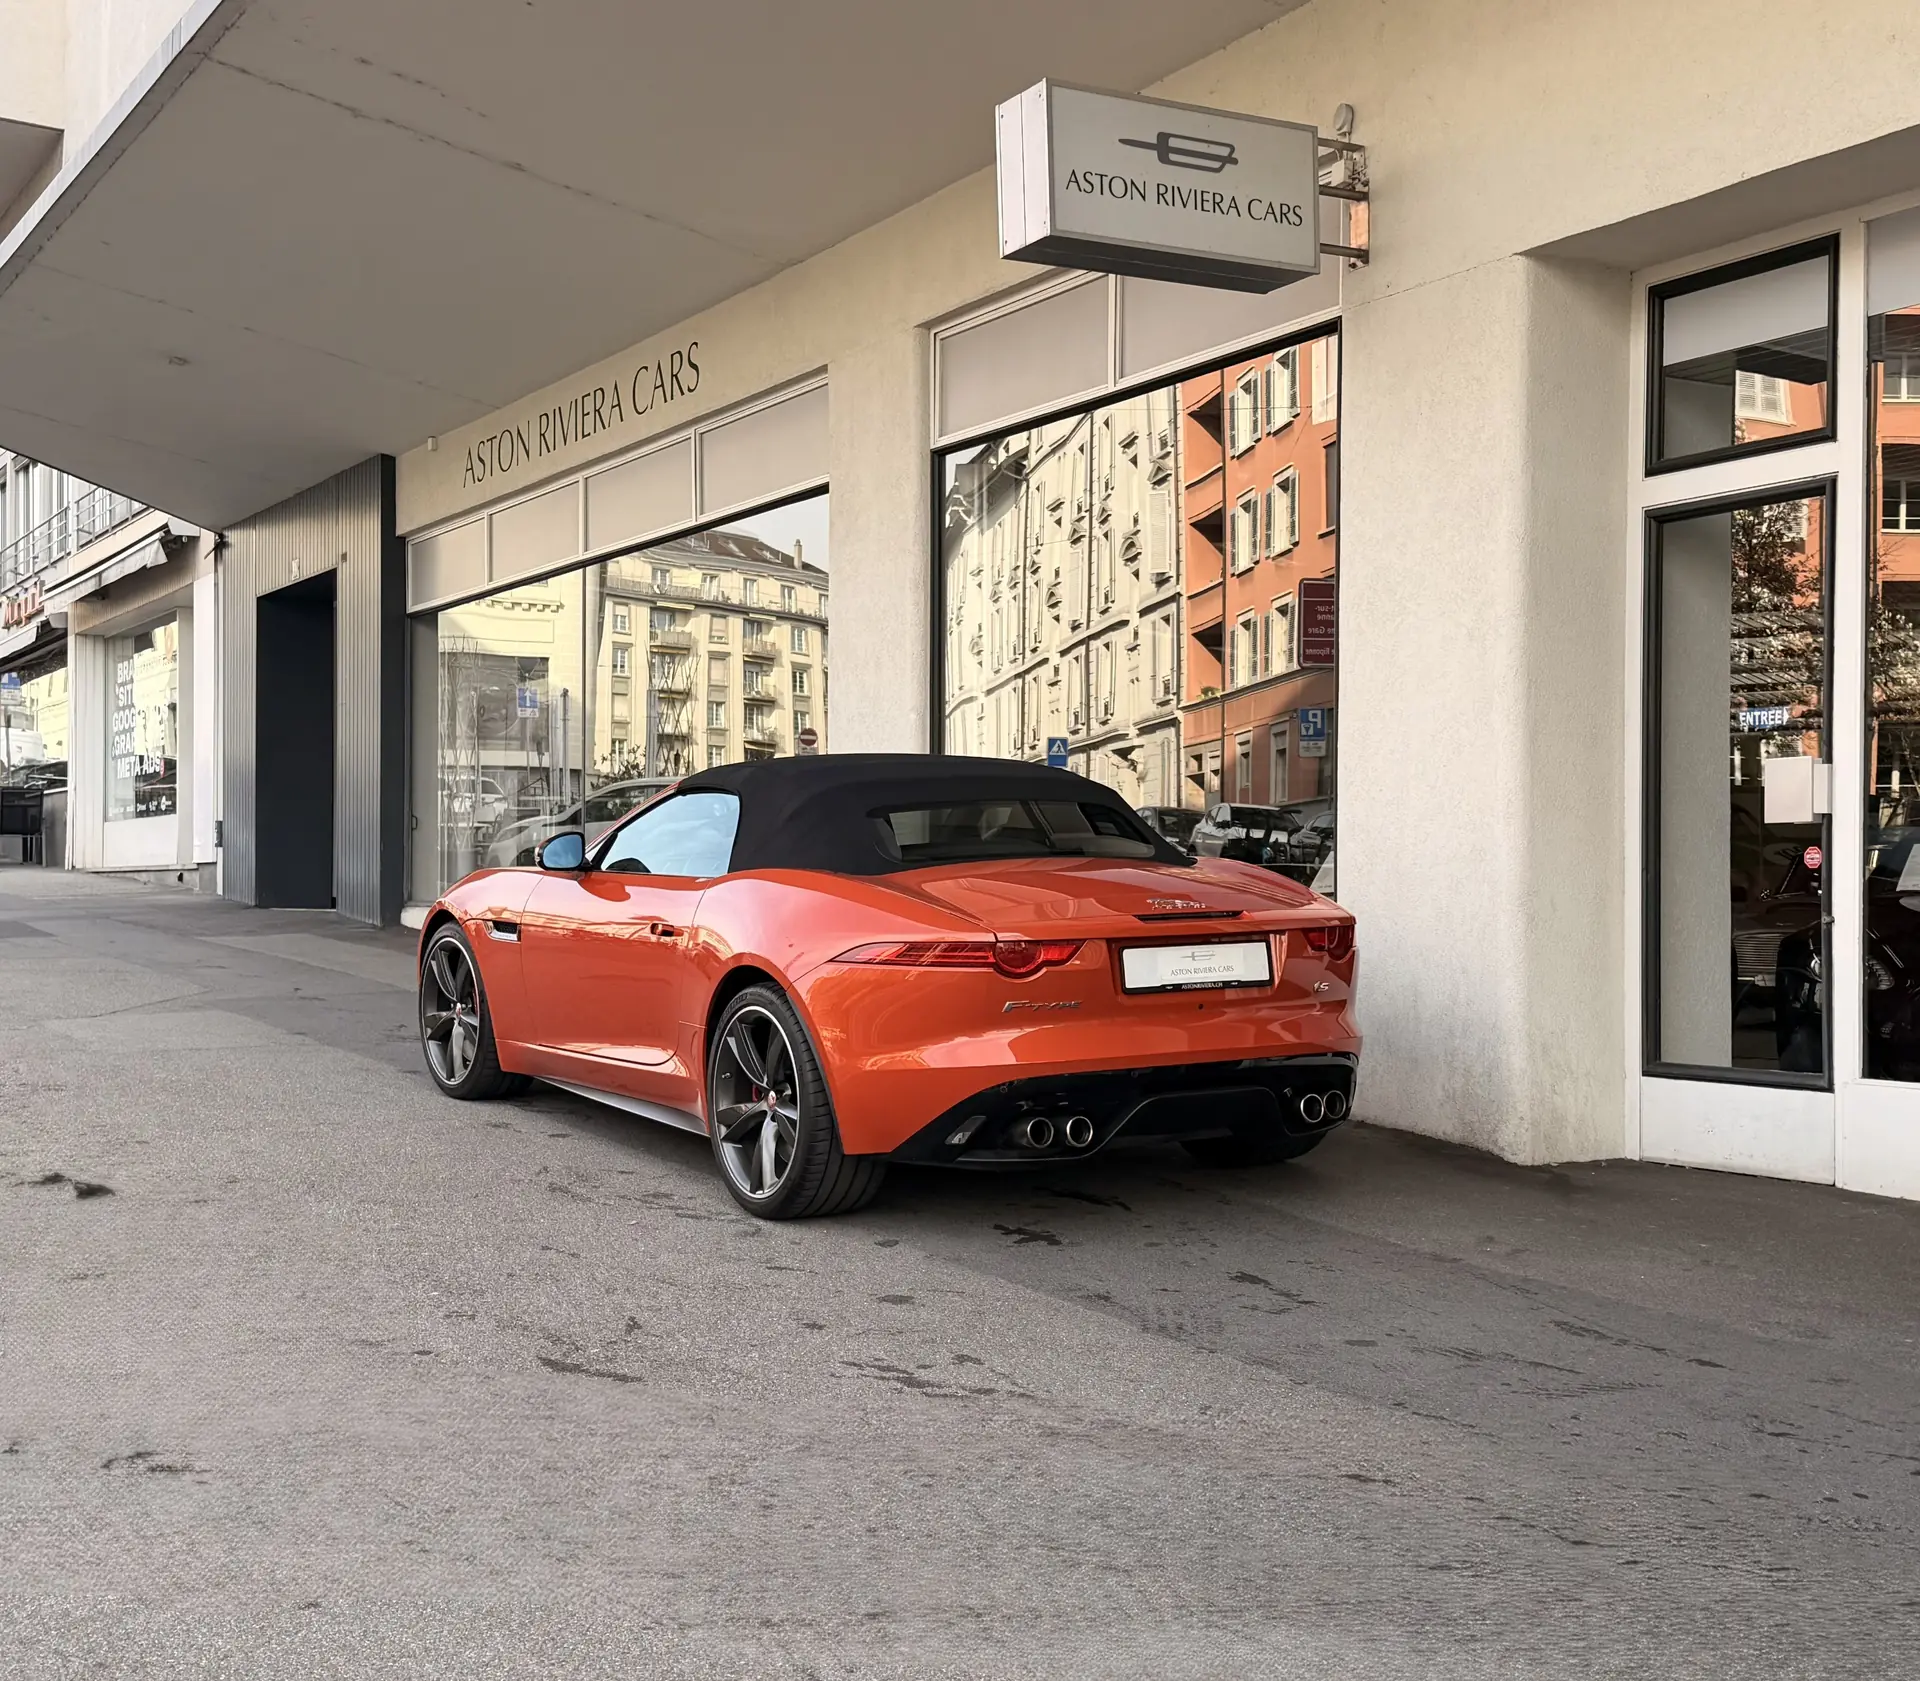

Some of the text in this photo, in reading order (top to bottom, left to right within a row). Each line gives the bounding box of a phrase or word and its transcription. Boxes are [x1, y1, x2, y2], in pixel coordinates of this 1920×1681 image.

[1066, 169, 1303, 227] ASTON RIVIERA CARS
[463, 341, 700, 488] ASTON RIVIERA CARS
[1739, 710, 1783, 726] ENTREE
[117, 755, 141, 779] META
[1170, 964, 1235, 977] ASTON RIVIERA CARS
